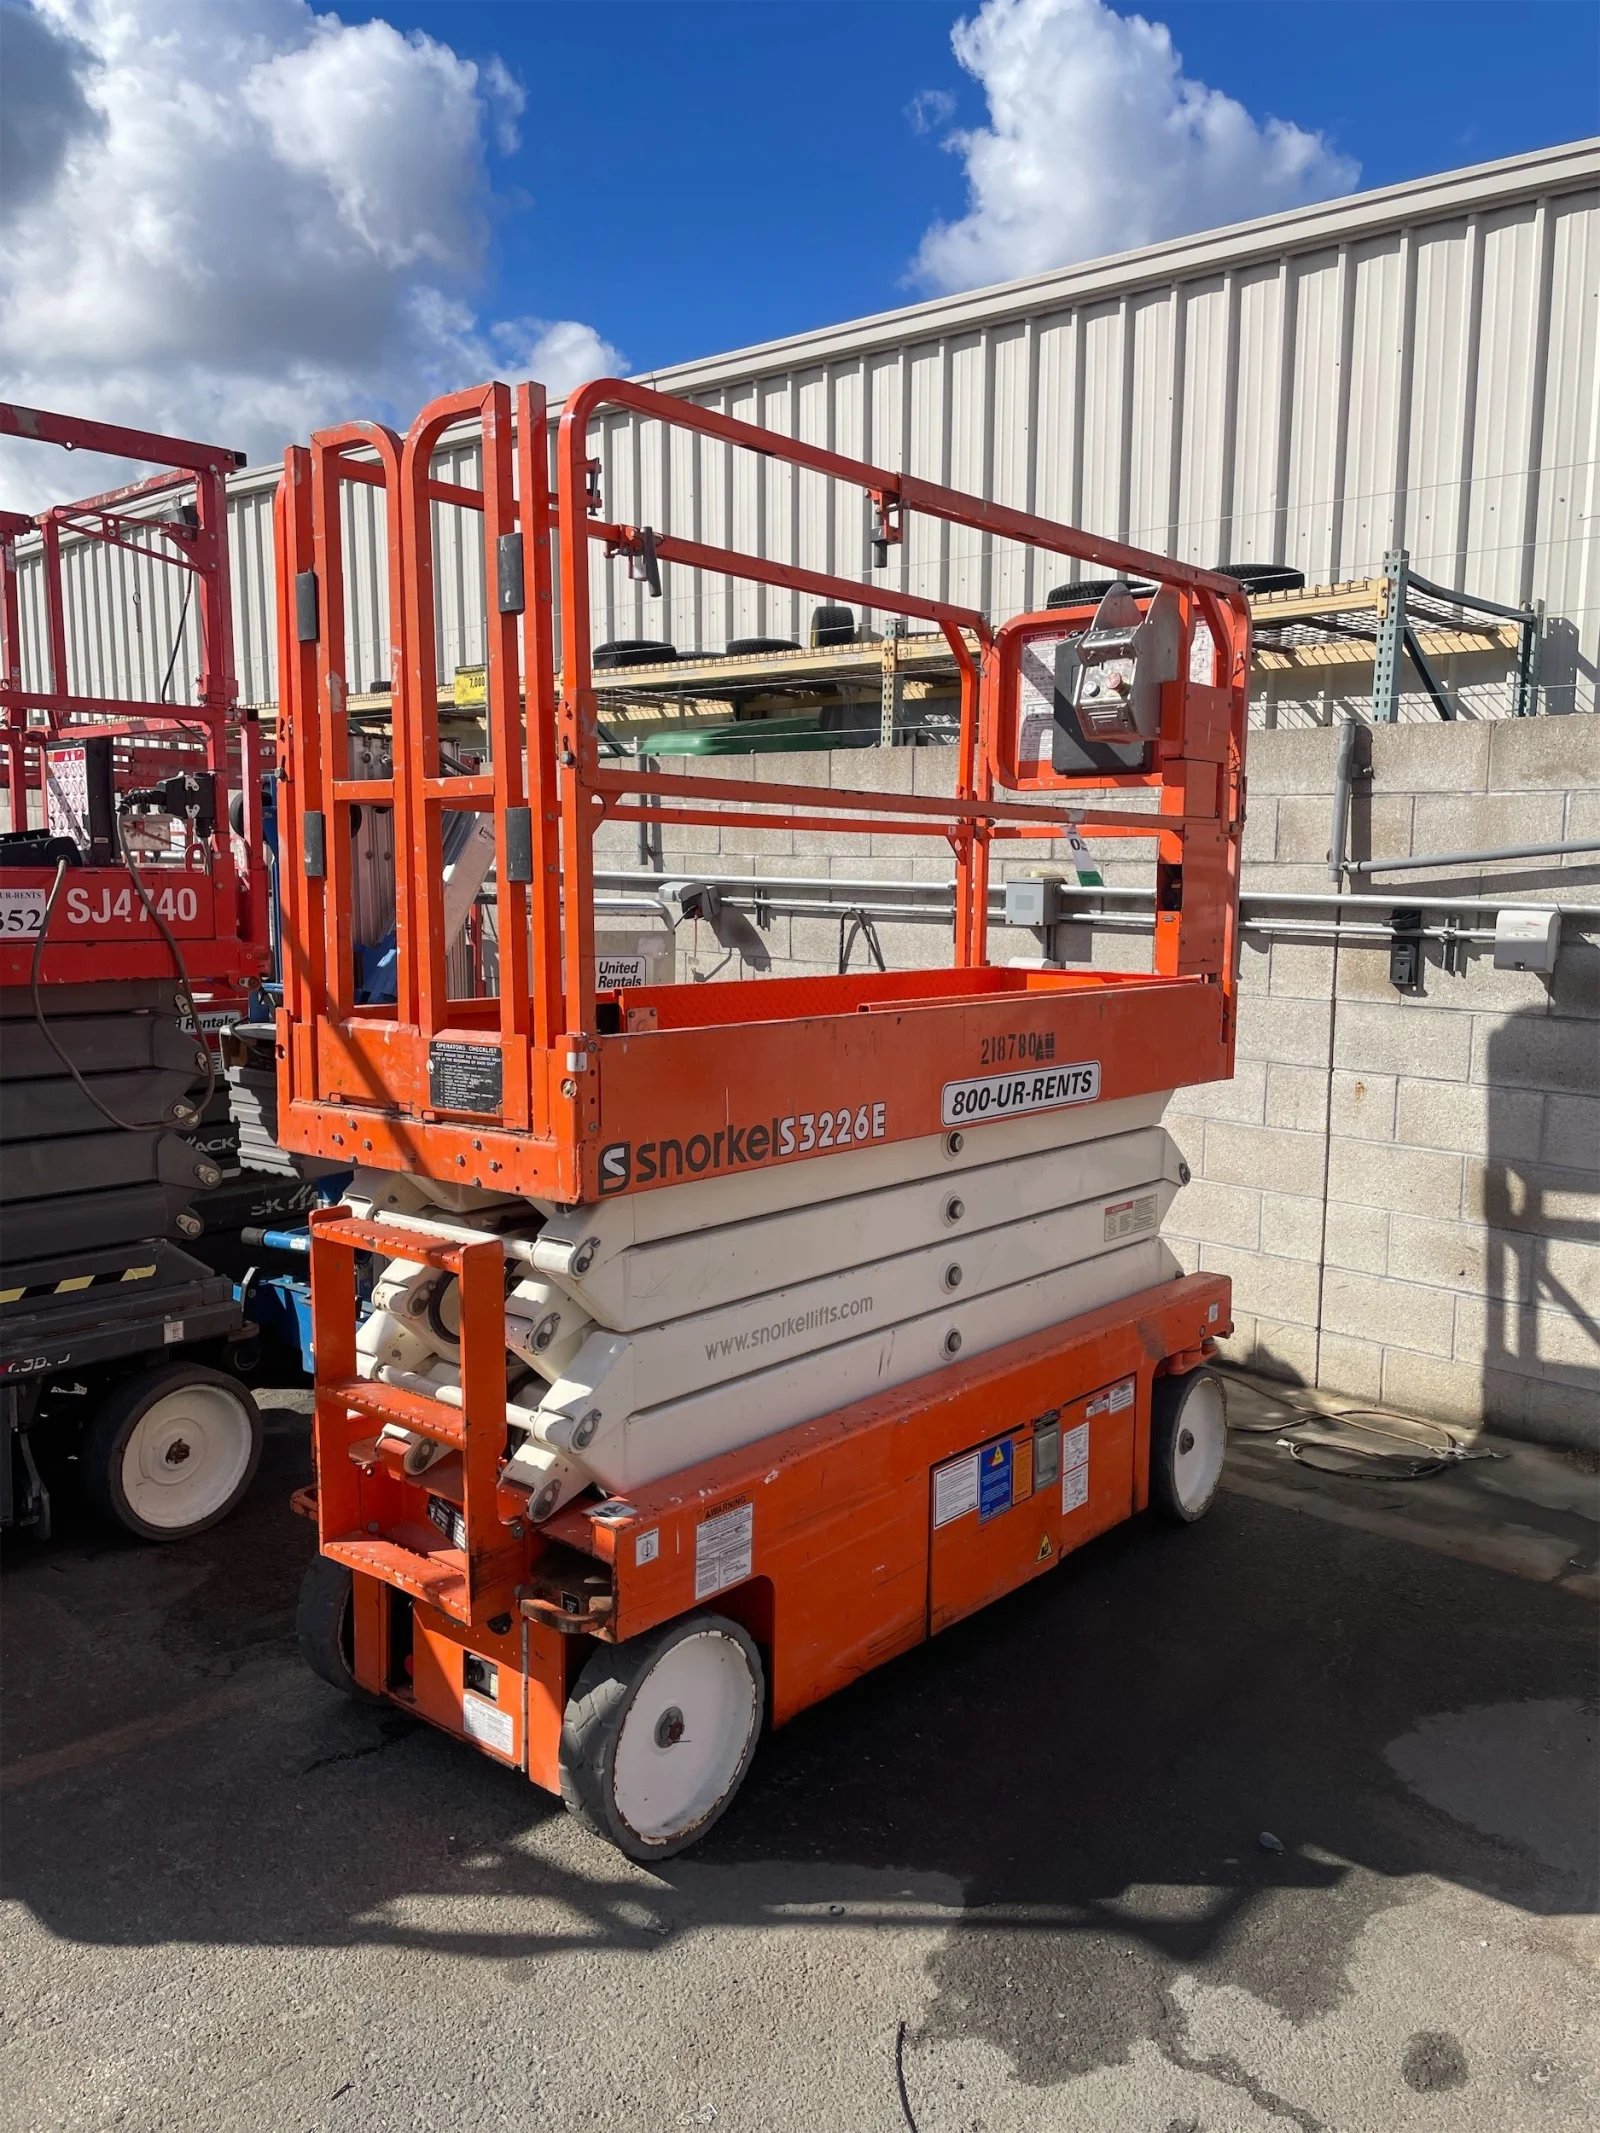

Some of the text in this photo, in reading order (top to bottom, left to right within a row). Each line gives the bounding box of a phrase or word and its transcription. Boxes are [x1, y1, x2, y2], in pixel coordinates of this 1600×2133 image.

[67, 888, 197, 924] SJ4740
[598, 961, 639, 975] United
[597, 975, 642, 989] Rentals
[185, 1014, 236, 1030] Rntals
[435, 1043, 497, 1054] OPERATORS CHECKLIST
[952, 1070, 1093, 1116] 800-UR-RENTS
[636, 1118, 779, 1183] snorkel
[779, 1102, 886, 1156] S3226E
[704, 1296, 874, 1361] www.snorkellifts.com
